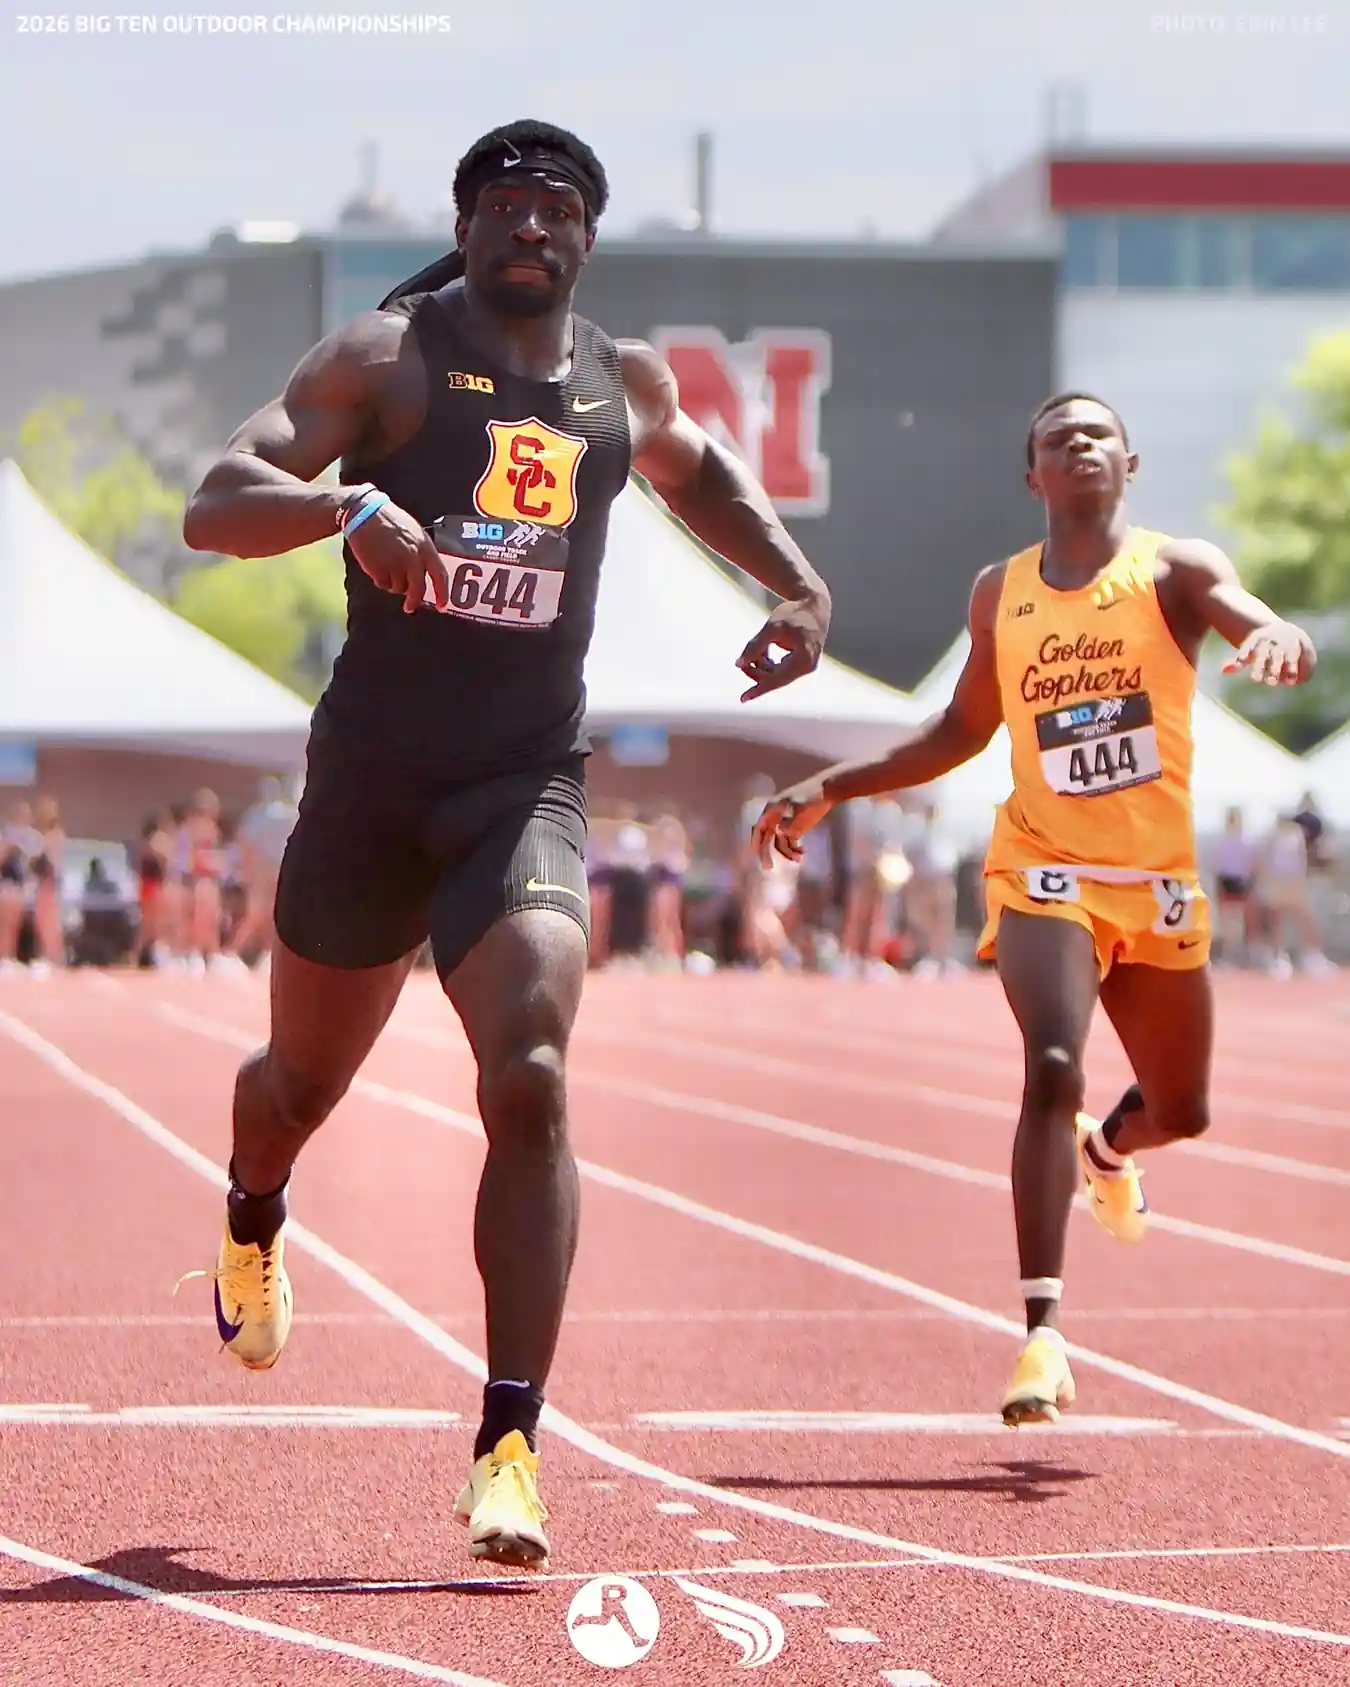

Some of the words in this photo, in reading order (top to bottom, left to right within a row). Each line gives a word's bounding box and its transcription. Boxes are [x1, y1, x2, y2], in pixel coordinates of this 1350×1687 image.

[449, 562, 539, 620] 644
[1038, 632, 1125, 665] Golden
[1020, 663, 1142, 706] Gophers
[1069, 736, 1140, 787] 444
